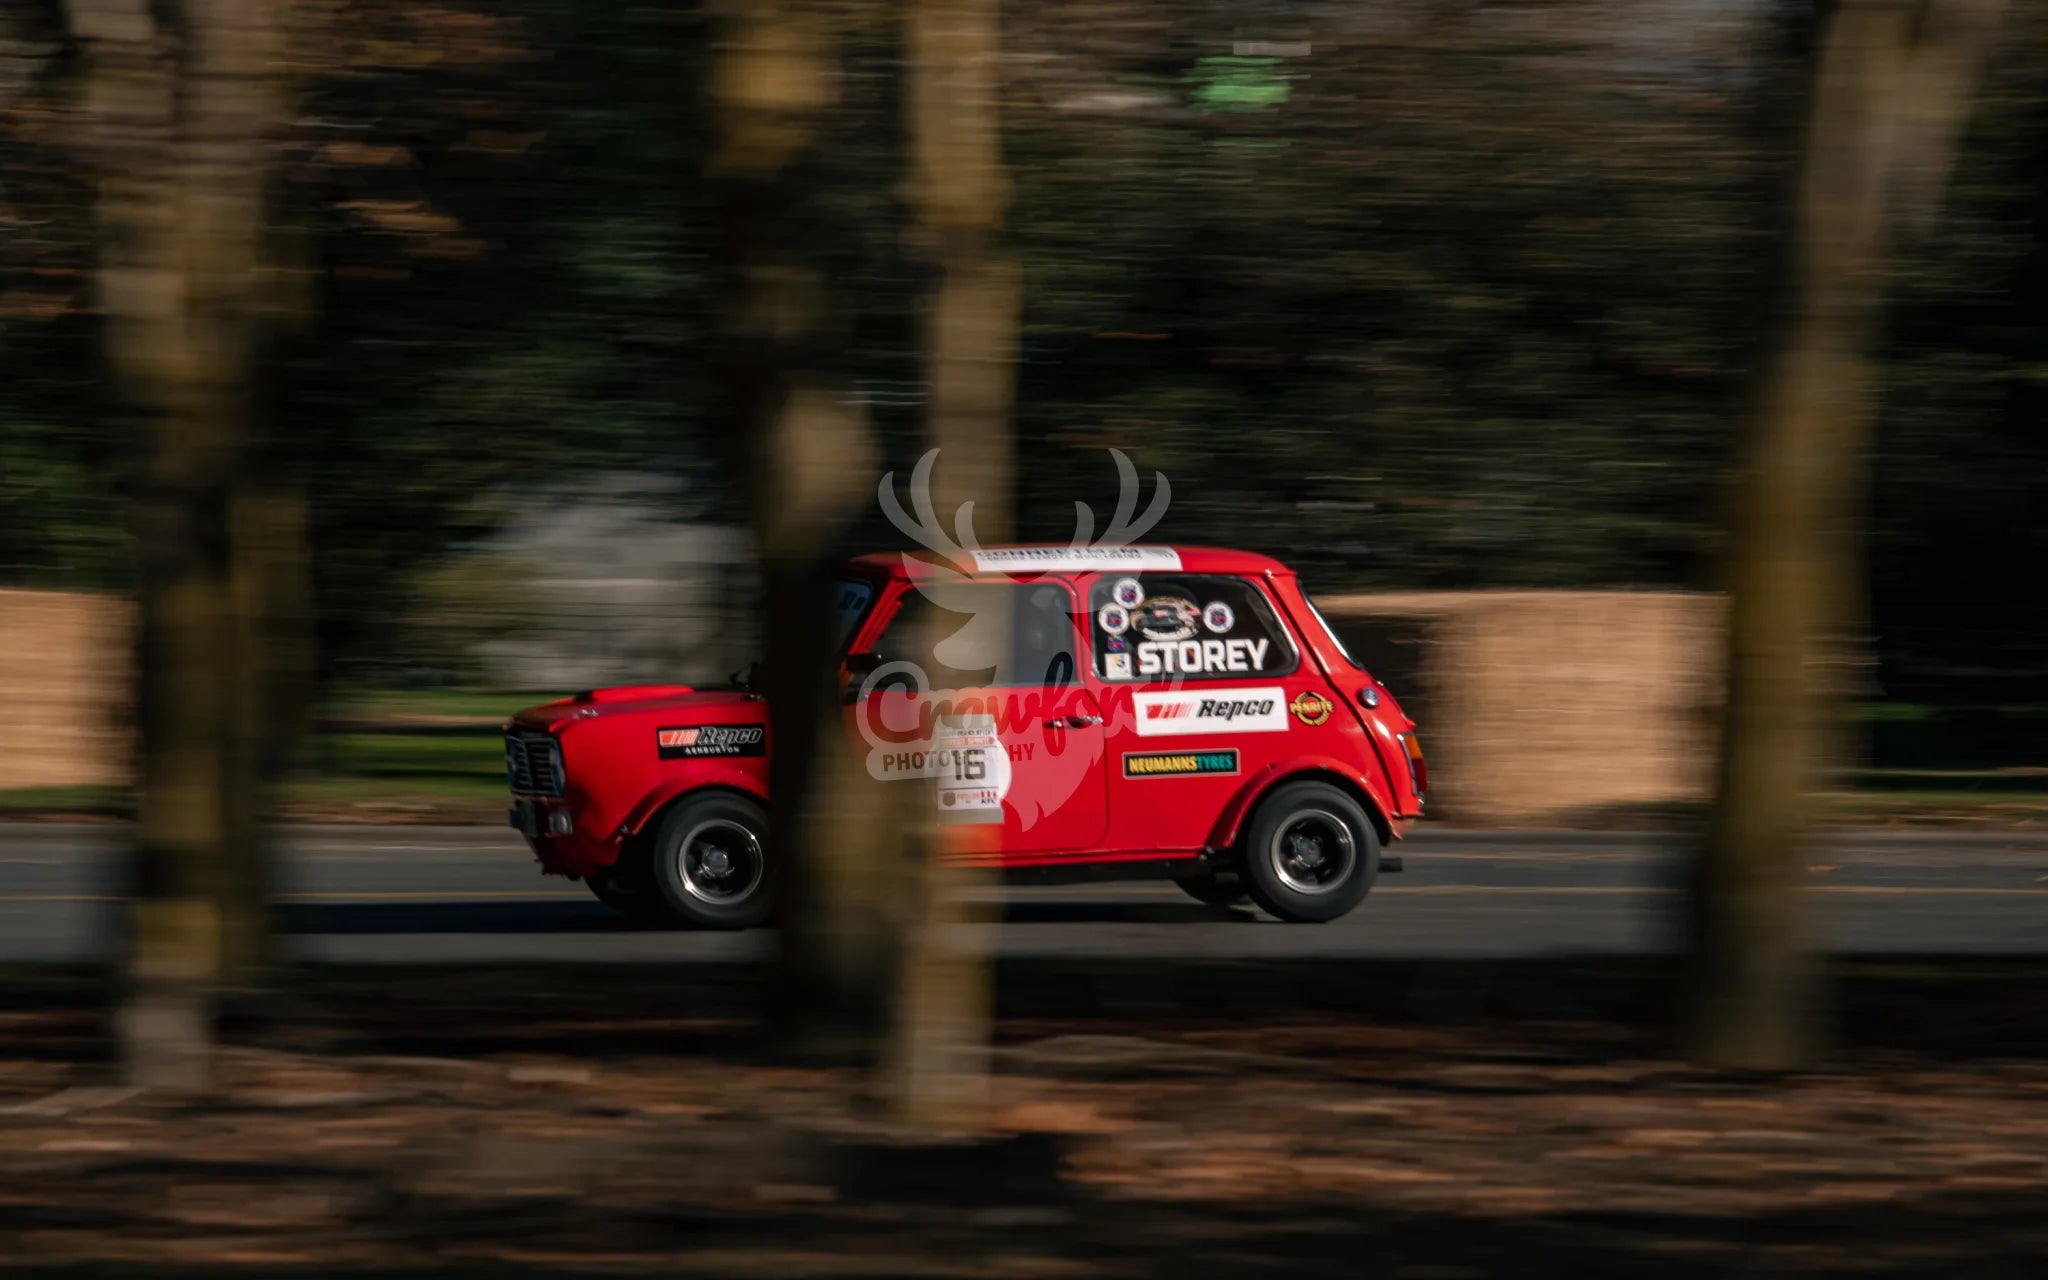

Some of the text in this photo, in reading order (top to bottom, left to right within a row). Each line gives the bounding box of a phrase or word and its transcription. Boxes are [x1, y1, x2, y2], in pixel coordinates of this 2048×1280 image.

[1138, 638, 1268, 674] STOREY
[1197, 698, 1274, 721] Repco
[698, 726, 762, 750] Repco
[951, 749, 986, 781] 16
